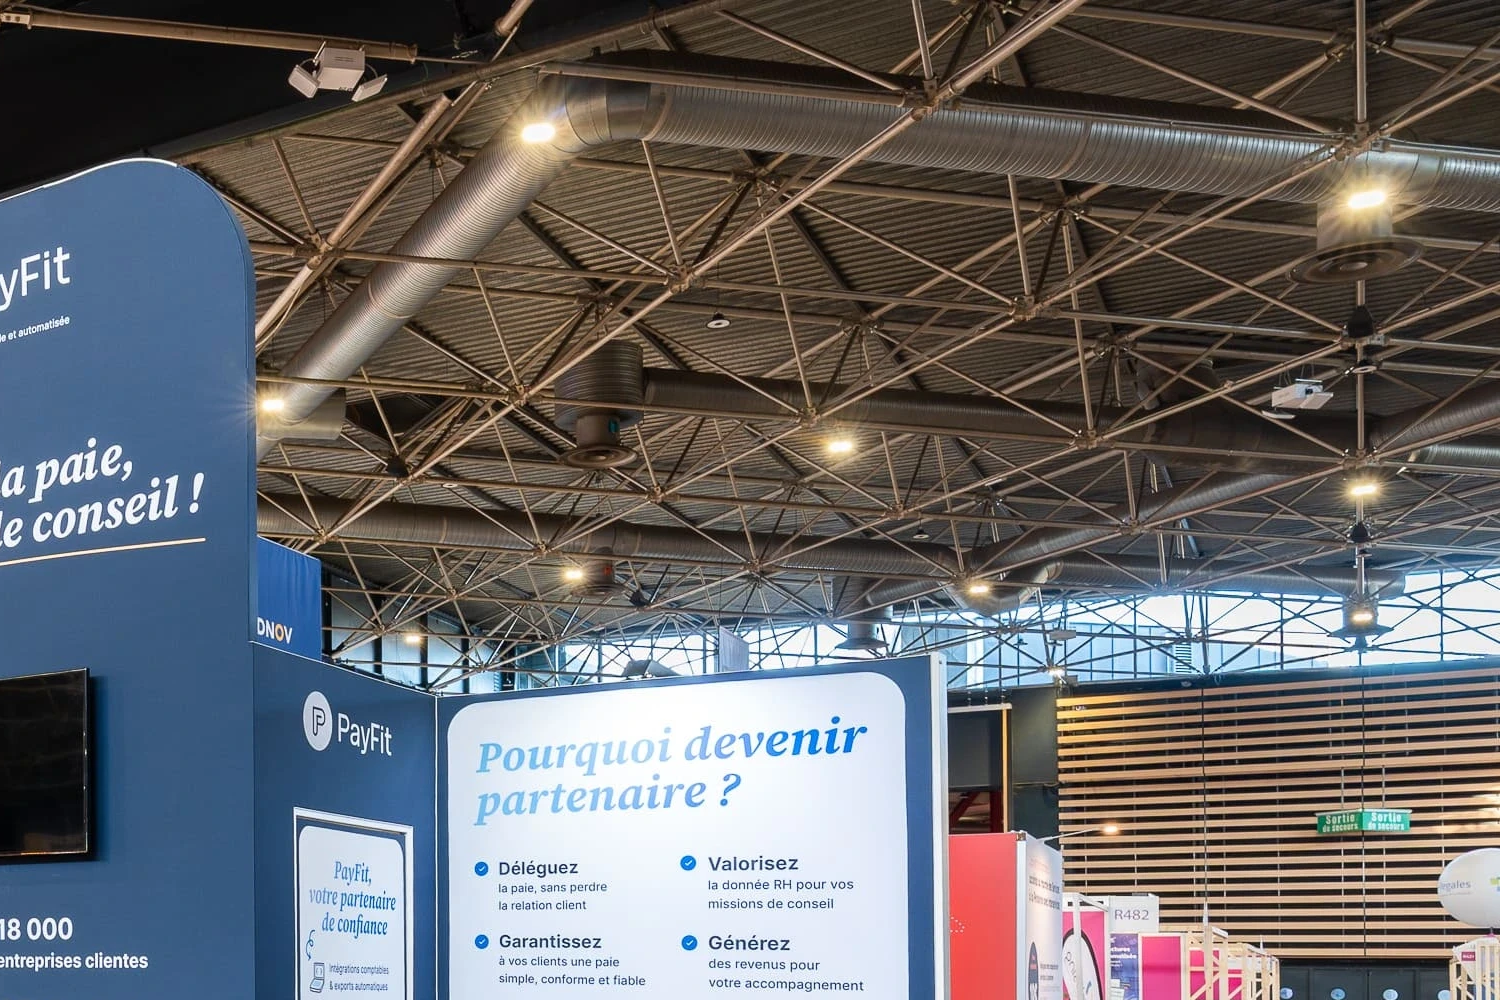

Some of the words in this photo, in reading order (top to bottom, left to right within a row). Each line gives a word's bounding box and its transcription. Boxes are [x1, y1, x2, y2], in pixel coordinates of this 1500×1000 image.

[8, 330, 17, 341] et
[18, 315, 70, 338] automatisée
[28, 437, 134, 504] paie,
[32, 473, 180, 543] conseil
[189, 473, 206, 514] !
[338, 712, 392, 756] PayFit
[475, 726, 672, 776] Pourquoi
[684, 715, 869, 761] devenir
[473, 773, 707, 826] partenaire
[719, 773, 742, 806] ?
[1325, 815, 1355, 825] Sortie
[1371, 812, 1402, 822] Sortie
[1332, 823, 1358, 832] secours
[1368, 822, 1376, 830] de
[1378, 822, 1405, 831] secours
[499, 860, 579, 878] Déléguez
[708, 856, 799, 871] Valorisez
[334, 860, 372, 886] PayFit,
[498, 883, 508, 893] la
[511, 882, 537, 895] paie,
[540, 884, 566, 892] sans
[570, 882, 608, 894] perdre
[708, 880, 718, 890] la
[722, 879, 770, 890] donnée
[773, 879, 792, 890] RH
[796, 880, 826, 892] pour
[830, 880, 854, 890] vos
[309, 887, 338, 905] votre
[339, 889, 396, 912] partenaire
[498, 901, 508, 910] la
[511, 901, 552, 910] relation
[555, 900, 587, 910] client
[708, 898, 763, 909] missions
[767, 898, 783, 909] de
[787, 898, 834, 909] conseil
[1114, 909, 1150, 921] R482
[27, 917, 74, 941] 000
[321, 911, 336, 932] de
[337, 914, 388, 939] confiance
[499, 934, 602, 949] Garantissez
[708, 935, 791, 951] Générez
[85, 952, 149, 969] clientes
[499, 955, 505, 966] à
[508, 957, 527, 966] vos
[530, 956, 567, 966] clients
[570, 958, 592, 967] une
[595, 957, 620, 969] paie
[708, 959, 731, 969] des
[735, 960, 786, 970] revenus
[790, 961, 820, 972] pour
[329, 963, 359, 975] Intégrations
[361, 965, 389, 975] comptables
[329, 981, 333, 990] &
[334, 982, 354, 992] exports
[355, 982, 388, 992] automatiques
[499, 974, 538, 985] simple,
[541, 974, 595, 985] conforme
[598, 976, 609, 985] et
[613, 975, 646, 986] fiable
[709, 979, 741, 988] votre
[745, 979, 864, 992] accompagnement
